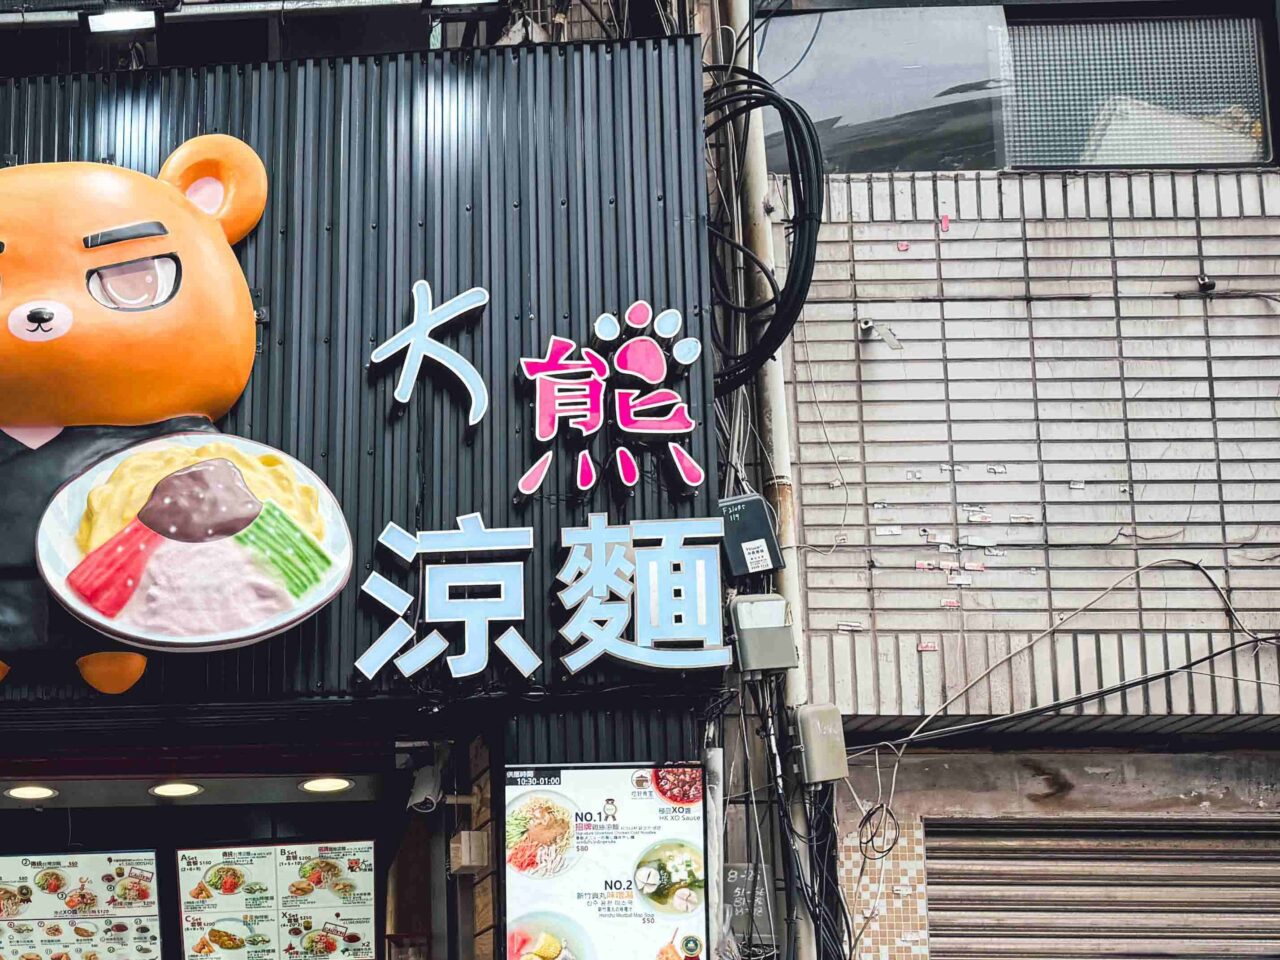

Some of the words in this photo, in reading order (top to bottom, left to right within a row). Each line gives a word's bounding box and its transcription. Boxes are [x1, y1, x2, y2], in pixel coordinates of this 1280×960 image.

[371, 279, 705, 495] 大熊
[354, 512, 732, 680] 涼麵
[575, 812, 602, 822] NO.1
[605, 880, 632, 890] NO.2
